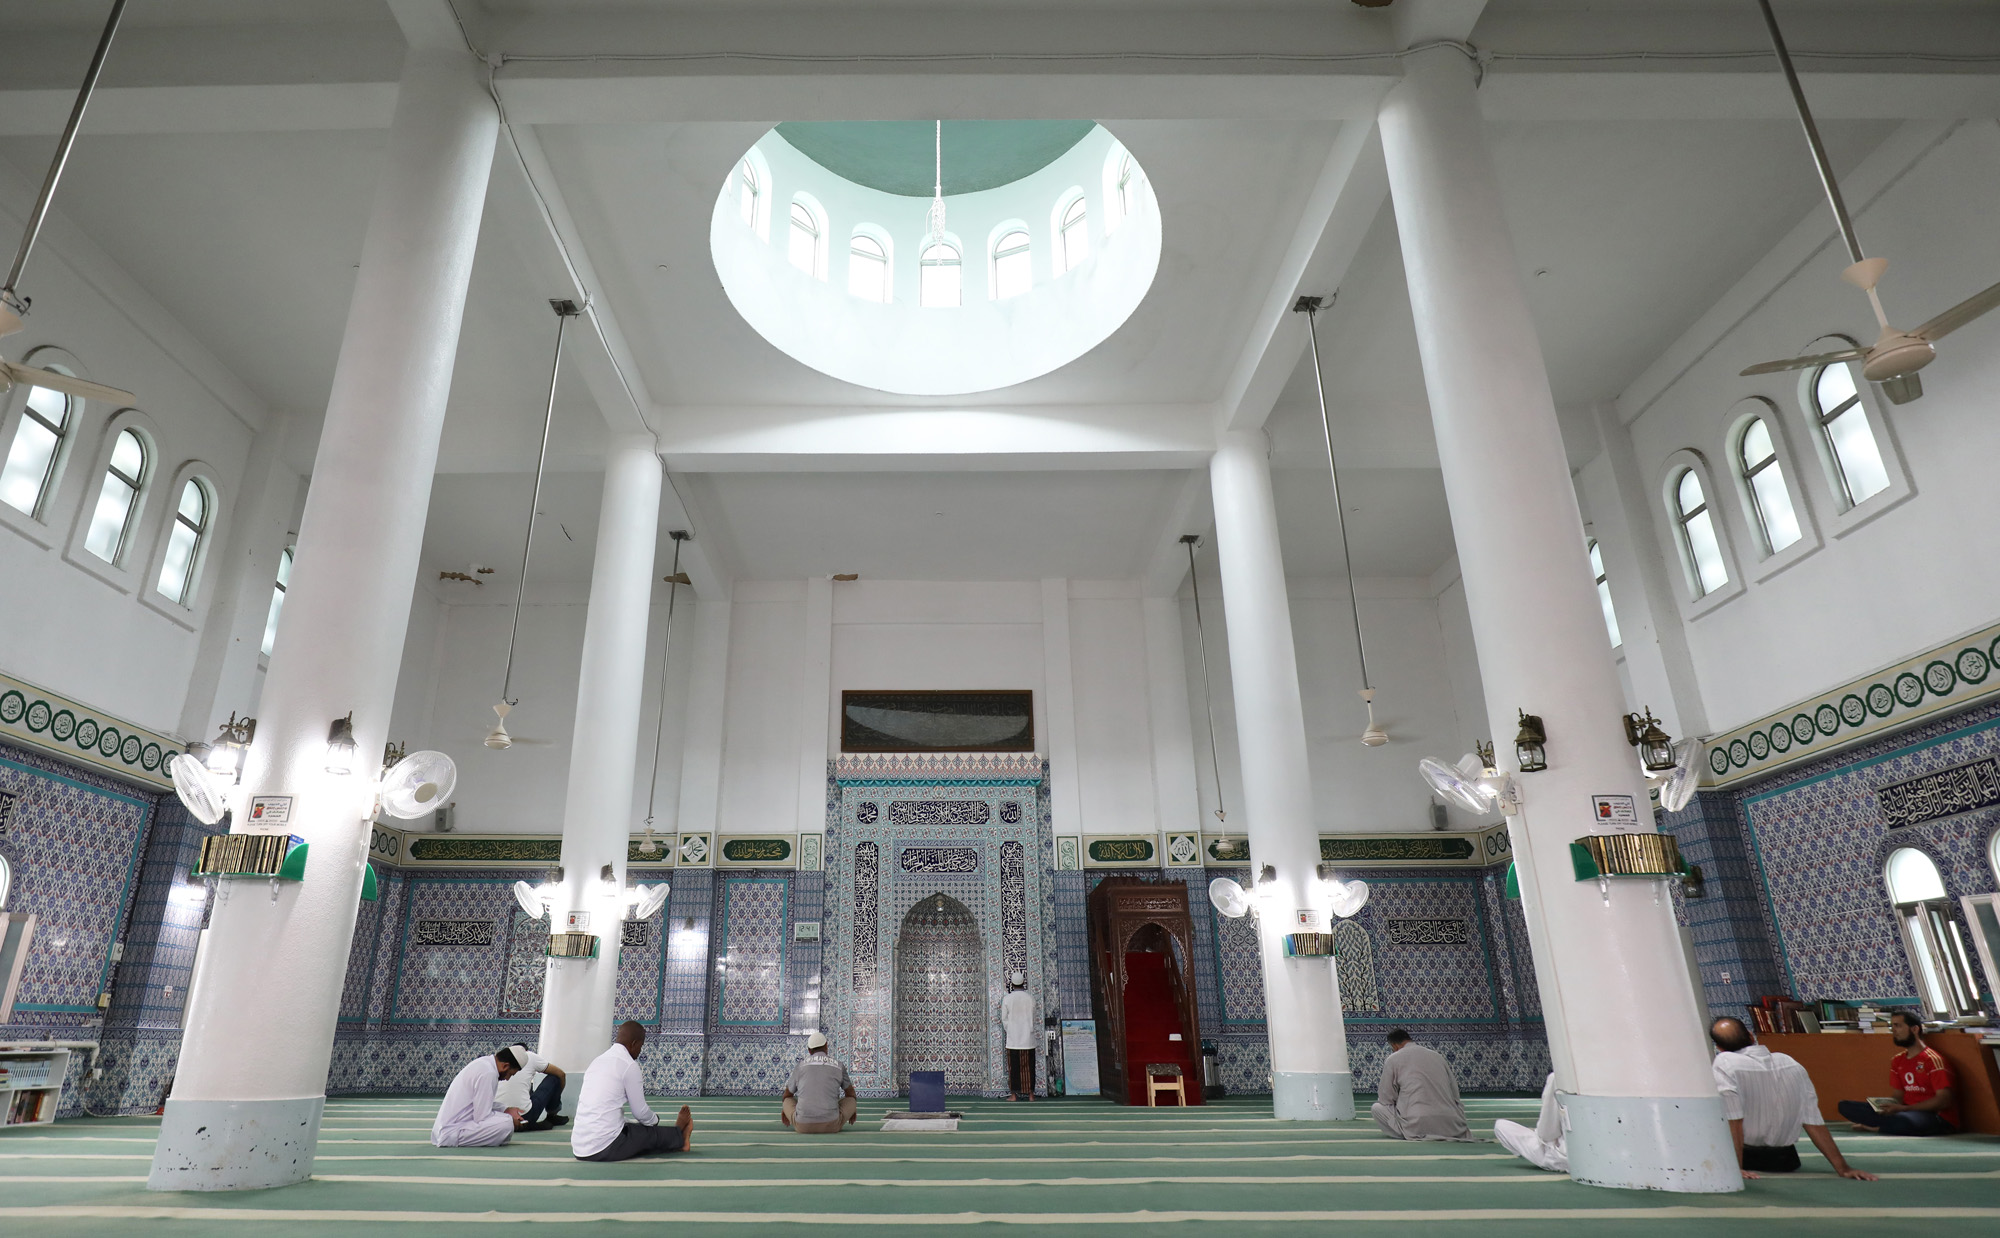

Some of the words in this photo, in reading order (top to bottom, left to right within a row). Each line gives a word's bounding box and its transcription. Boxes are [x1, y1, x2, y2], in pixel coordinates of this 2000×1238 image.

[1000, 802, 1021, 822] الله
[686, 840, 704, 858] محمد
[732, 842, 748, 858] الله
[746, 842, 765, 859] رسول
[761, 842, 783, 858] محمد
[1098, 842, 1114, 859] الله
[1174, 839, 1191, 858] الله
